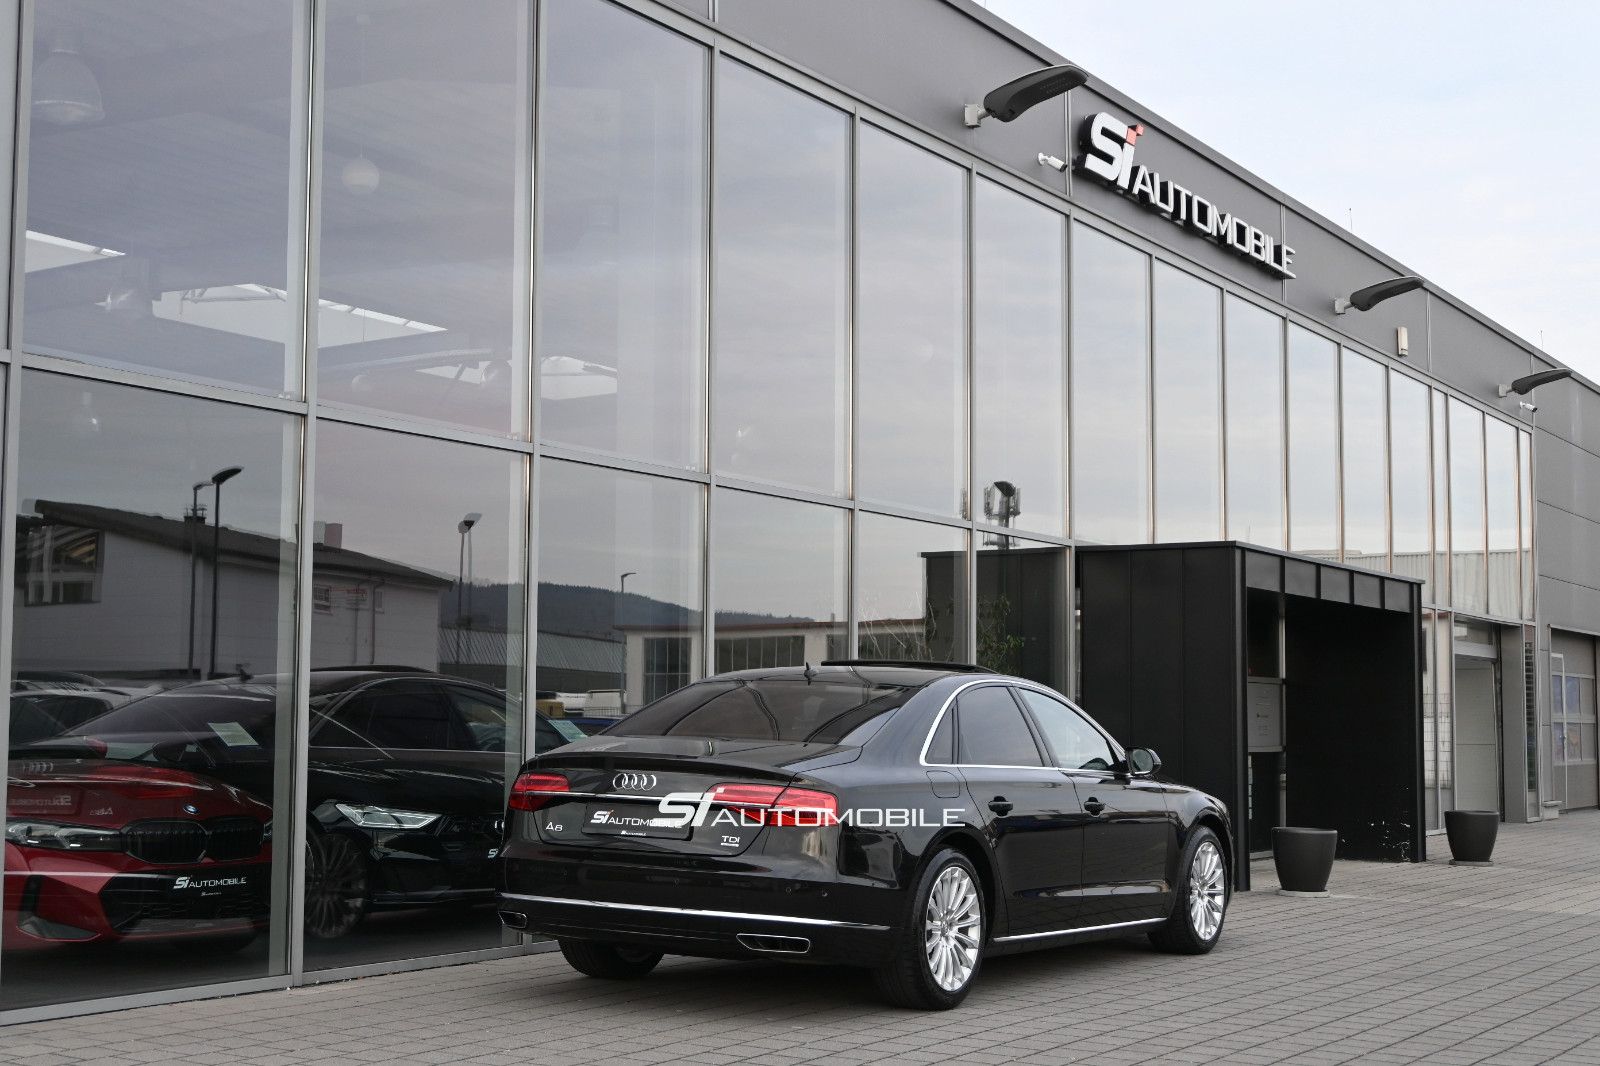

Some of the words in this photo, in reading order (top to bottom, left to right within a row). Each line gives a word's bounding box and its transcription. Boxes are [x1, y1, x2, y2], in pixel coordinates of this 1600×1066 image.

[1132, 164, 1297, 279] AUTOMOBILE
[545, 821, 563, 832] A8
[721, 835, 741, 843] TDI
[188, 876, 247, 888] AUTOMOBILE
